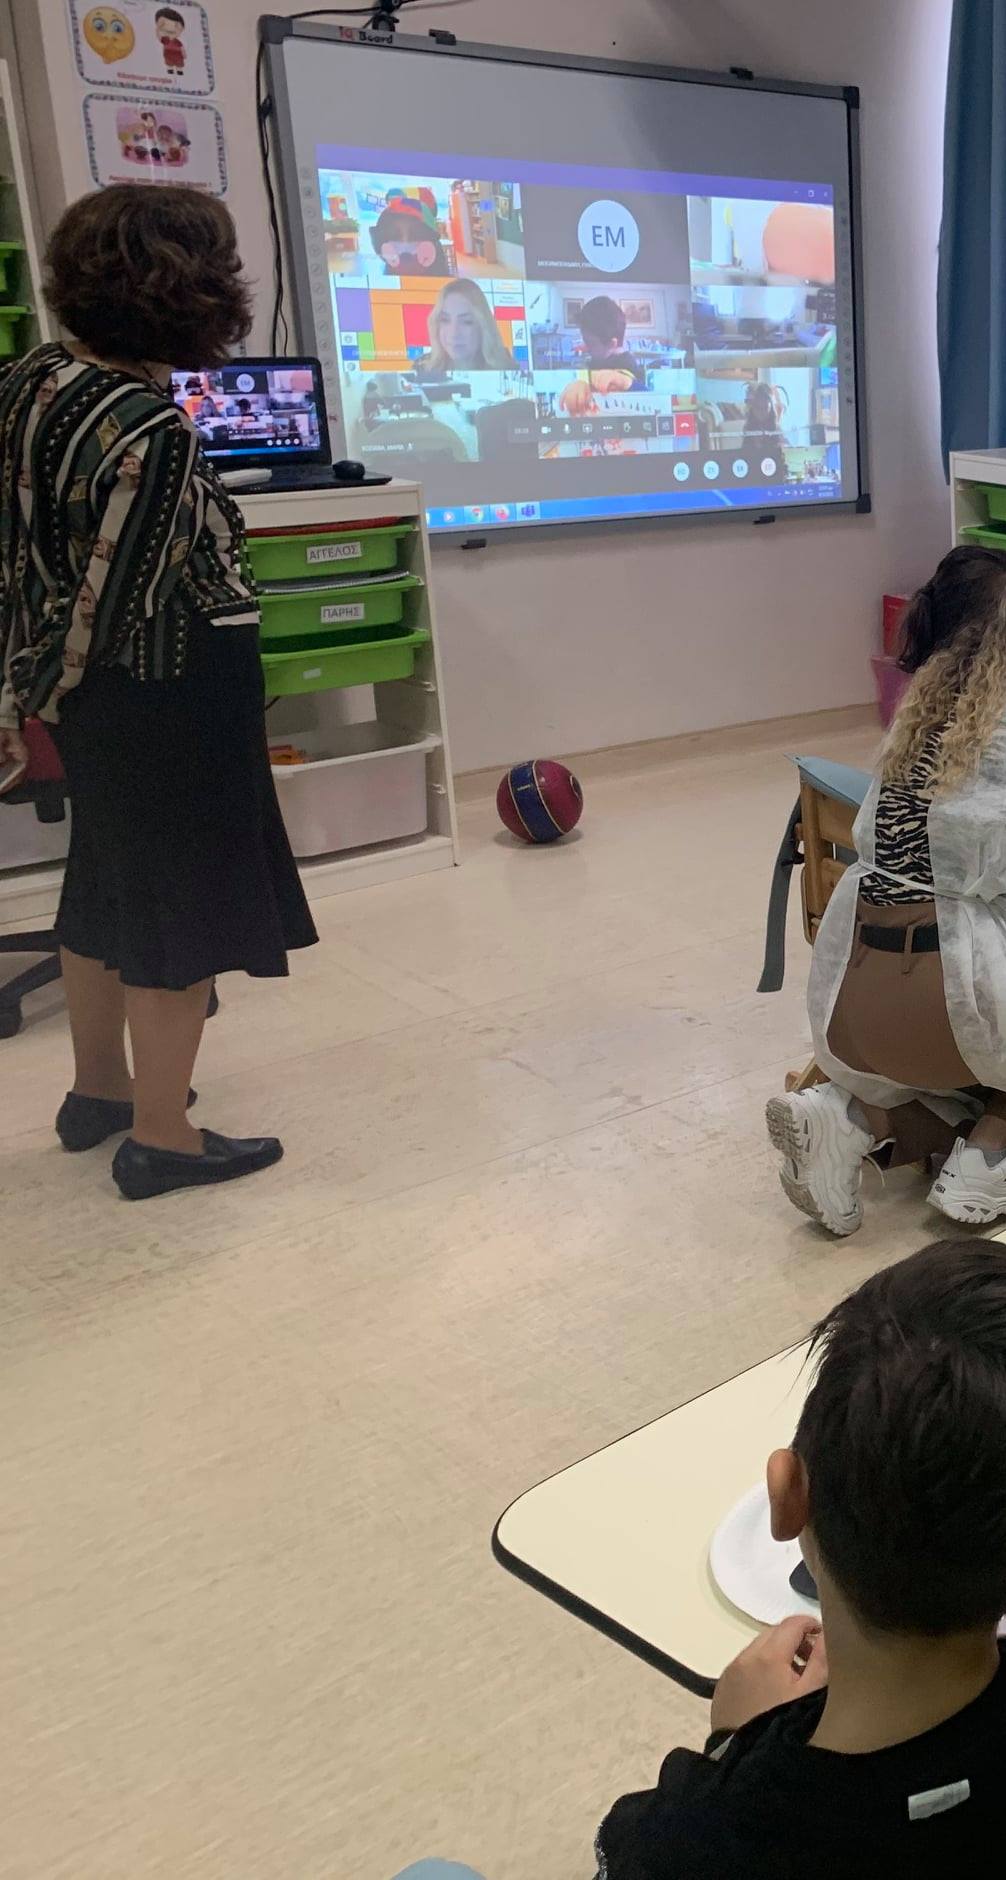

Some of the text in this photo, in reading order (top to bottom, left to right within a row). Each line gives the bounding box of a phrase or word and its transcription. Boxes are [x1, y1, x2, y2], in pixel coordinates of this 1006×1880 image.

[359, 31, 393, 44] Board
[592, 225, 625, 248] EM
[309, 544, 358, 561] ΑΓΓΕΛΟΣ
[322, 606, 360, 619] ΠΑΡΗΣ
